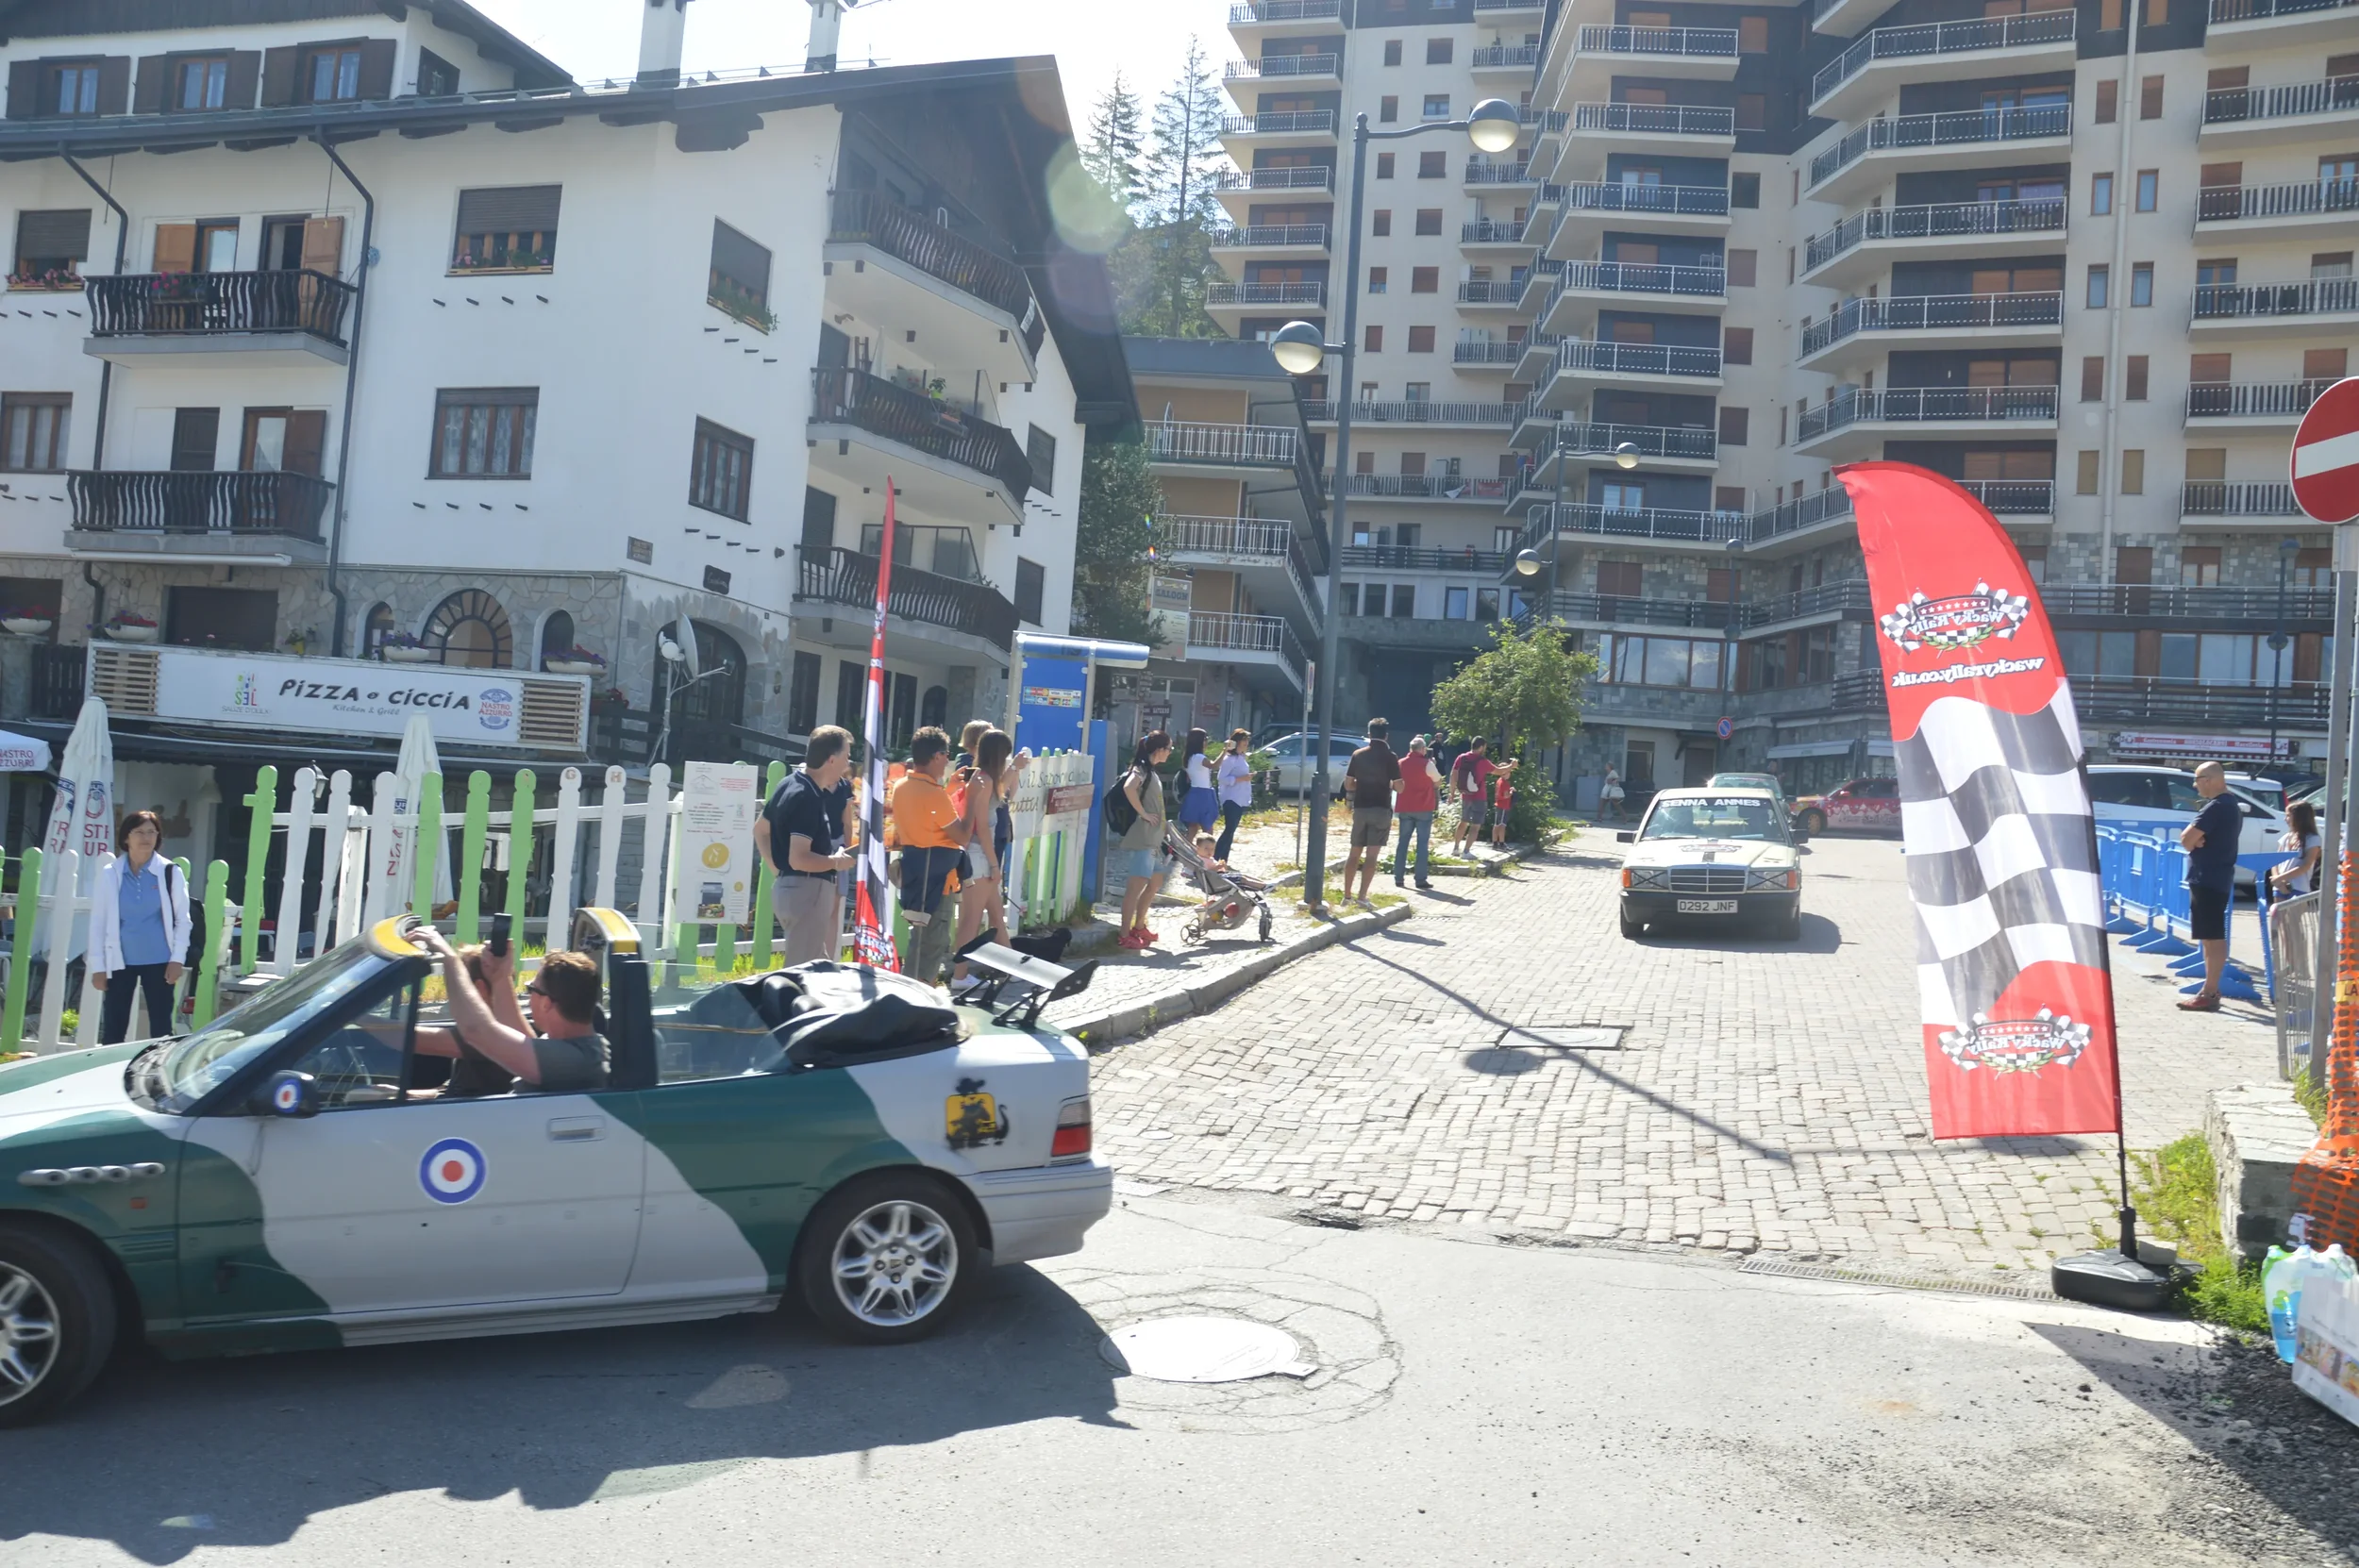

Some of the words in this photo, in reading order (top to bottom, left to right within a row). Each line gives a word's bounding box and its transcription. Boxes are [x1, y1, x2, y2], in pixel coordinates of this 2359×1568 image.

[332, 704, 366, 714] Kitchen
[481, 701, 510, 710] NASTRO
[478, 708, 513, 717] AZZURRO
[1661, 798, 1708, 808] SENNA
[1714, 798, 1761, 807] ANNES
[1679, 901, 1709, 911] D292
[1713, 901, 1735, 911] JNF
